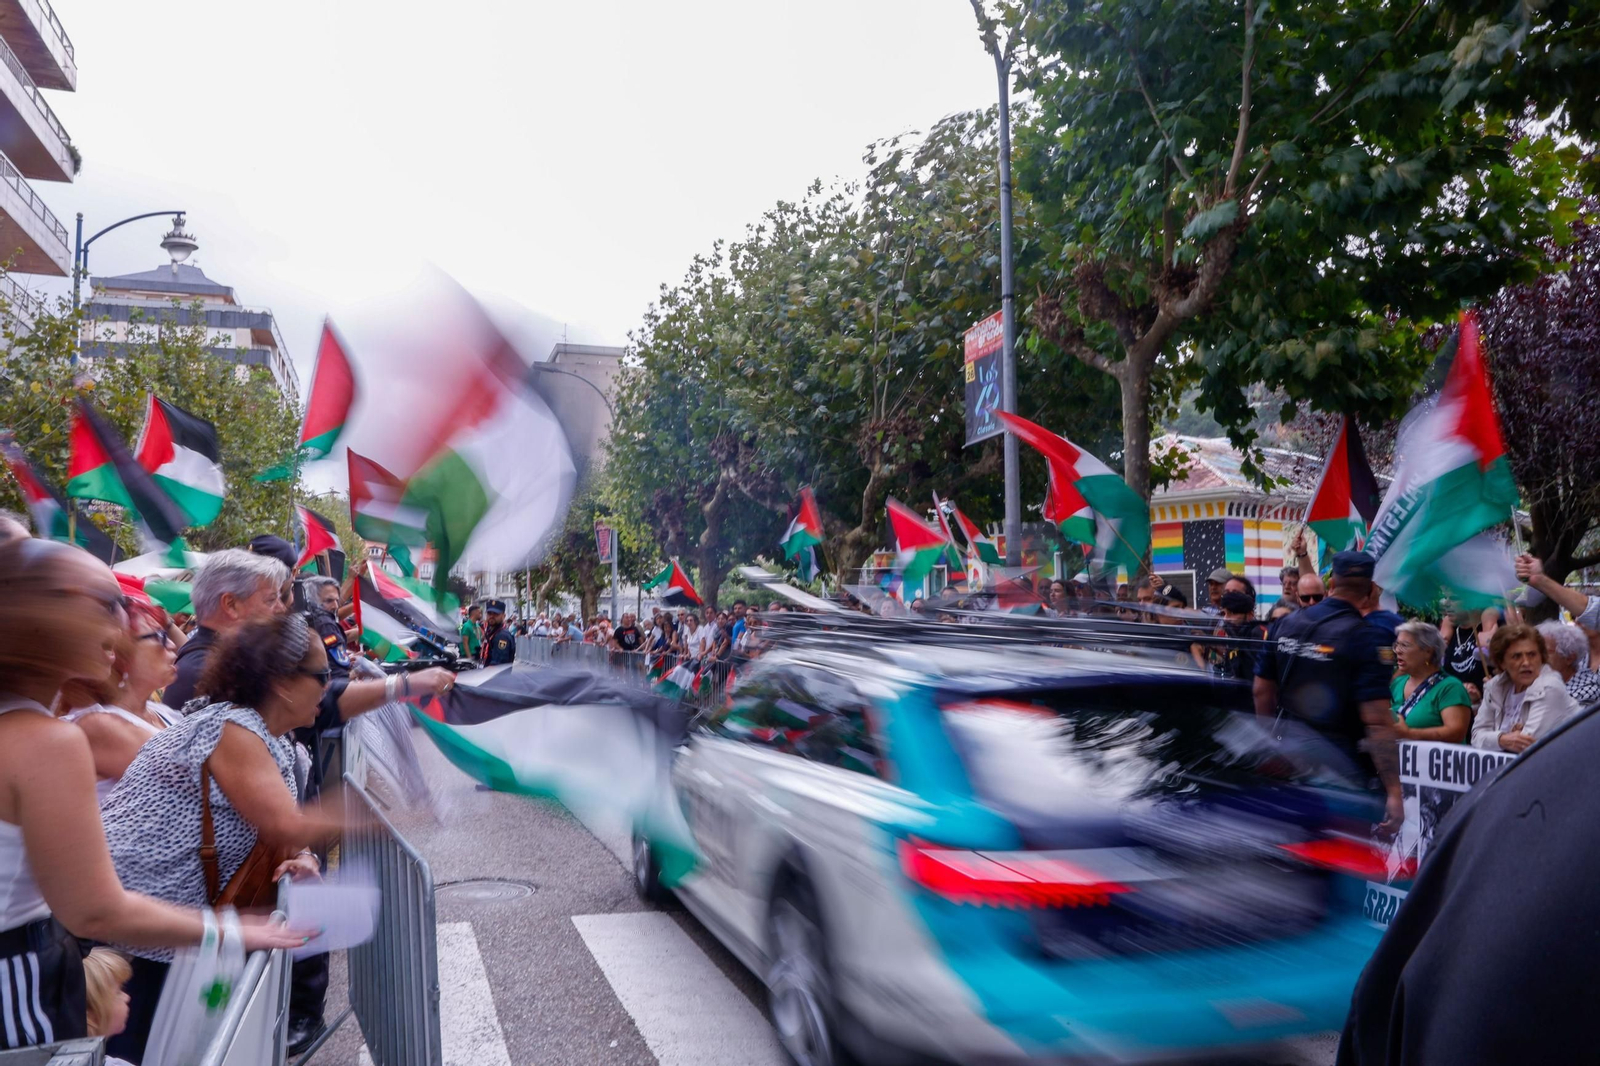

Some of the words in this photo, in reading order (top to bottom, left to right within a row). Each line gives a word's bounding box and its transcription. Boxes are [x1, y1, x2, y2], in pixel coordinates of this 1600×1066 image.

[1402, 744, 1420, 778] EL
[1428, 747, 1514, 786] GENOC
[1363, 888, 1403, 925] SRA
